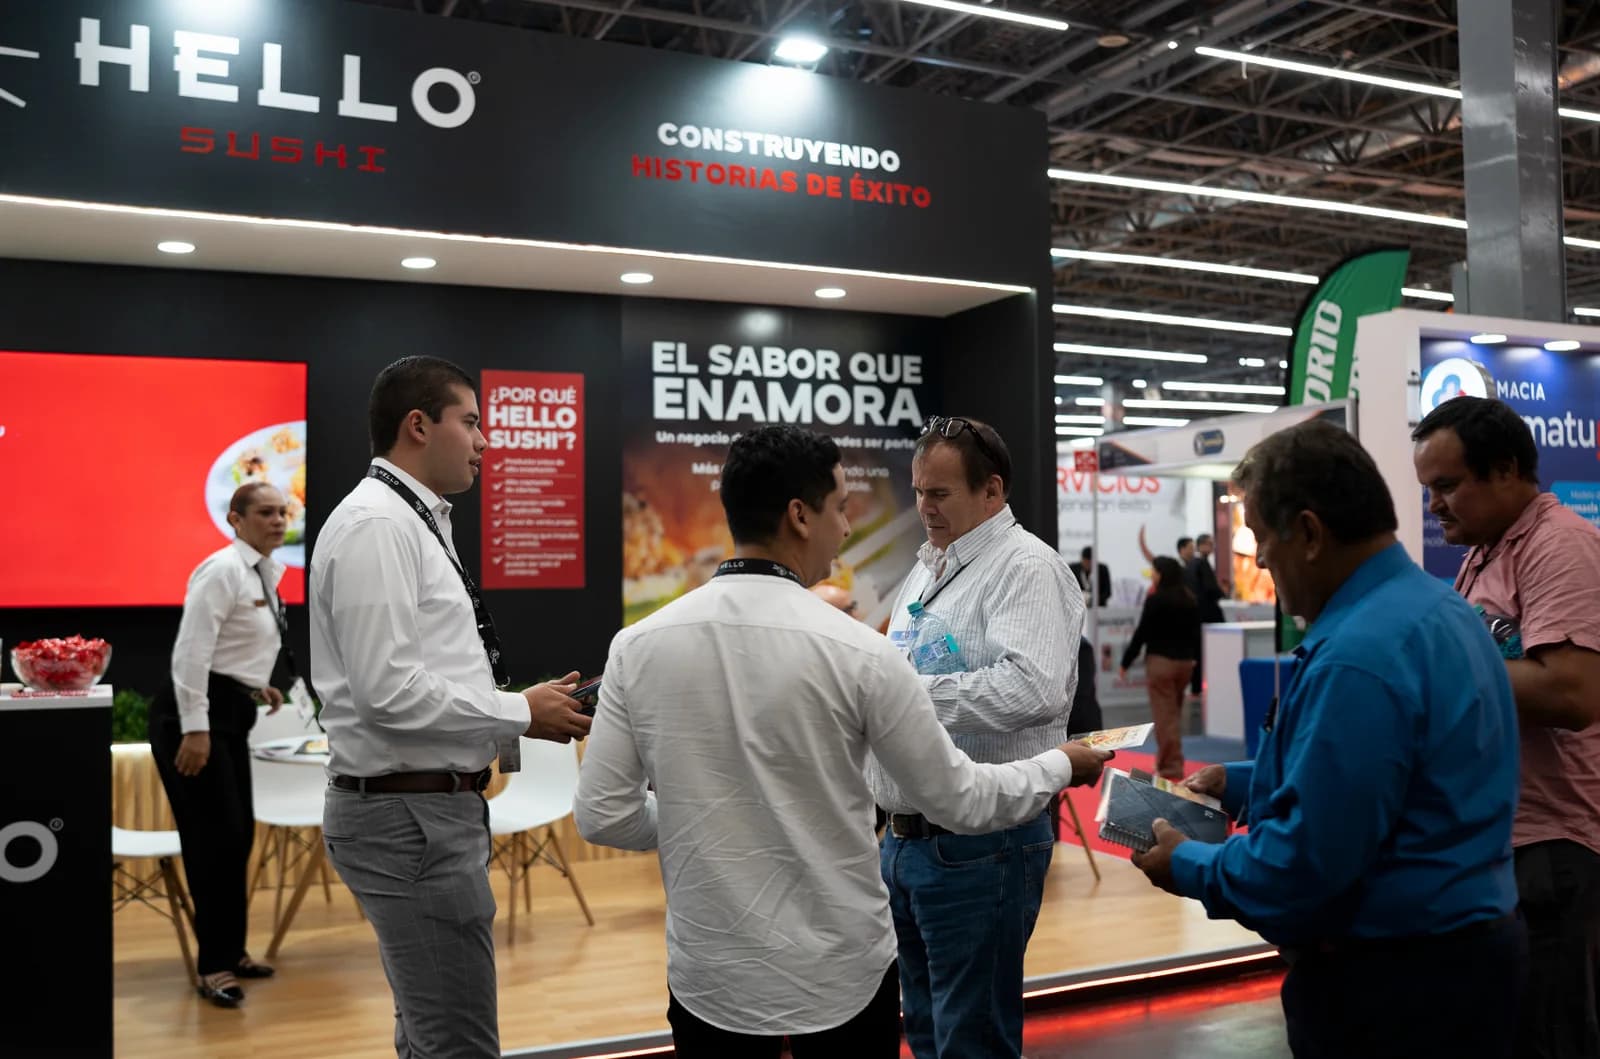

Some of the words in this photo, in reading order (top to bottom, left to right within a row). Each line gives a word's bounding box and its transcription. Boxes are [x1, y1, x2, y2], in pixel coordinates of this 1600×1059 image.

[179, 125, 386, 174] SUSHI
[657, 121, 901, 173] CONSTRUYENDO
[631, 152, 798, 194] HISTORIAS
[806, 172, 843, 200] DE
[849, 170, 932, 209] ÉXITO
[652, 340, 700, 375] EL
[707, 343, 842, 381] SABOR
[848, 351, 924, 385] QUE
[487, 404, 578, 430] HELLO
[488, 386, 537, 405] ¿POR
[538, 385, 578, 406] QUÉ
[653, 376, 925, 428] ENAMORA
[655, 430, 676, 443] Un
[676, 431, 731, 448] negocio
